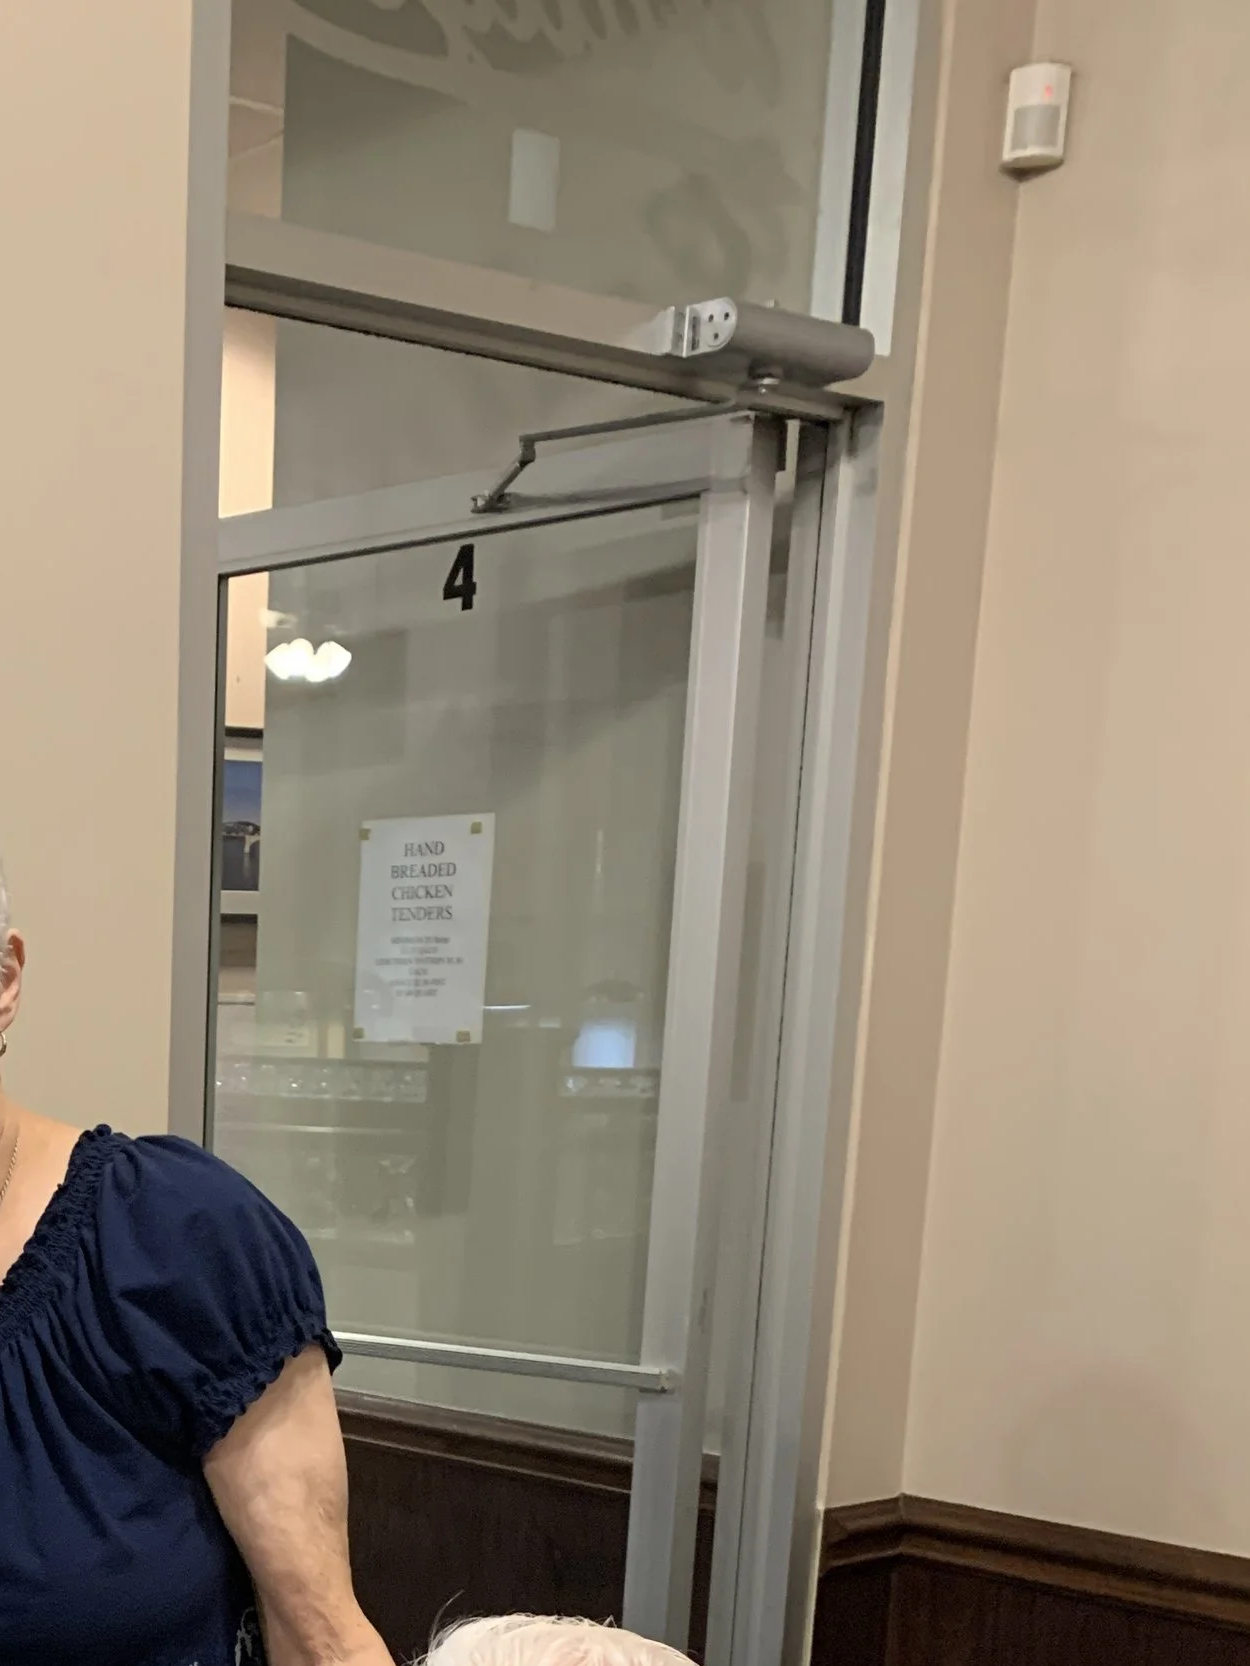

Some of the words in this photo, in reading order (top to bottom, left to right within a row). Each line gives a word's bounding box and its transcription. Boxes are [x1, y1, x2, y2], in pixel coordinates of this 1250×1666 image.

[443, 543, 477, 611] 4
[404, 841, 445, 857] HAND
[391, 862, 457, 879] BREADED
[391, 884, 454, 900] CHICKEN
[391, 906, 453, 922] TENDERS
